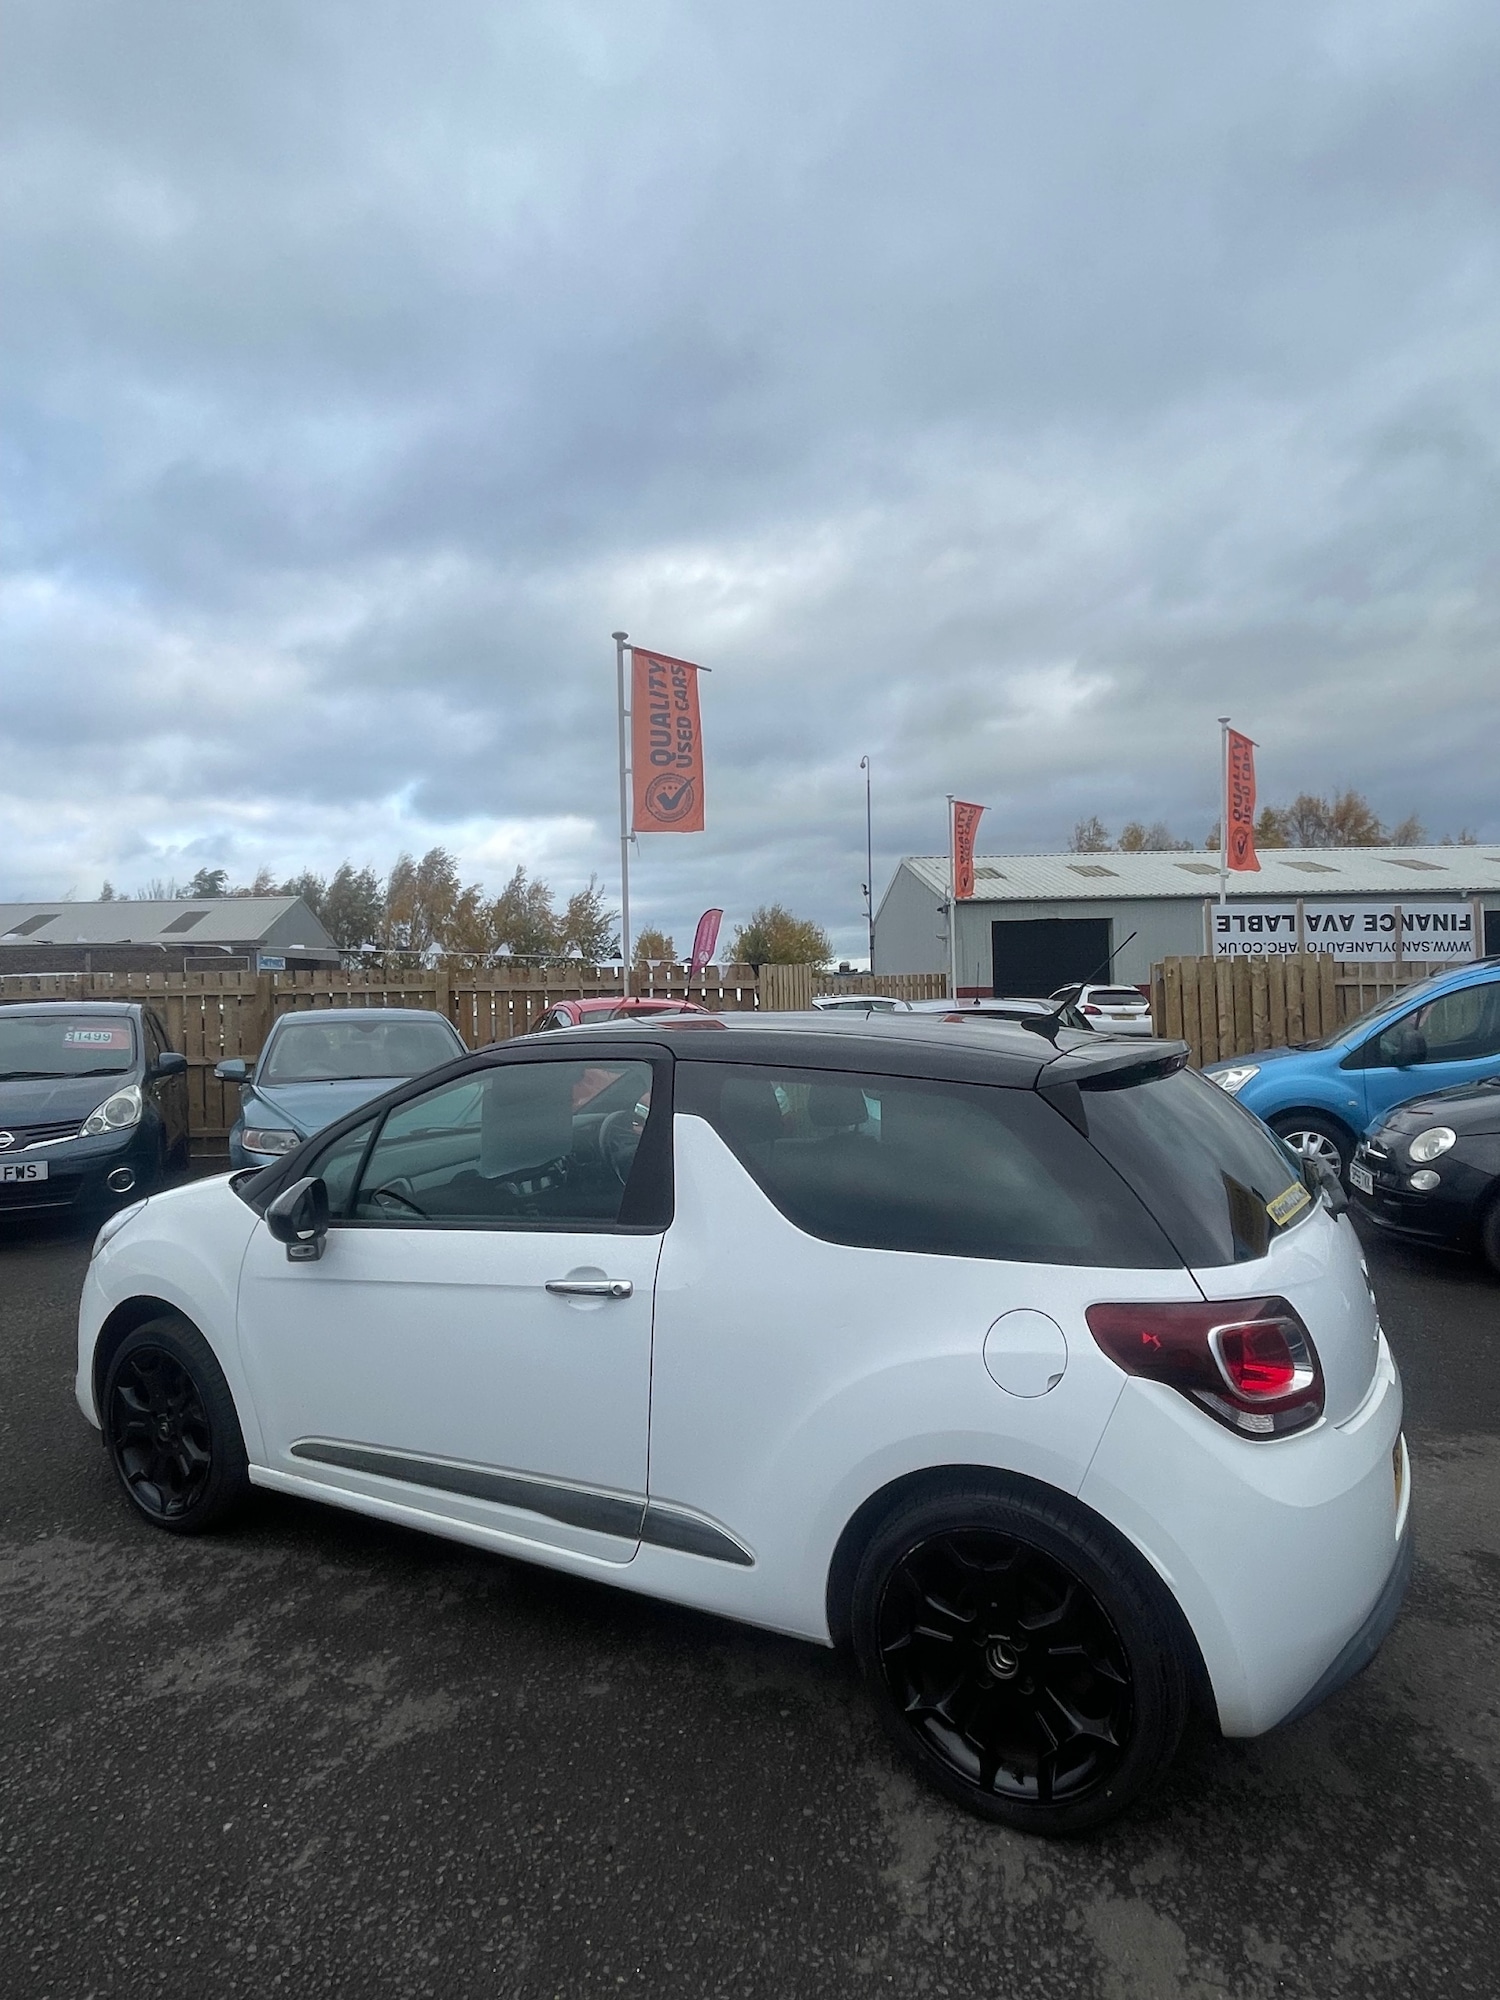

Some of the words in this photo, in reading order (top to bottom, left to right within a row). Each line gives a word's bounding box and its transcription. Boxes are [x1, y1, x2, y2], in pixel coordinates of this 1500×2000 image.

[671, 664, 690, 712] CARS
[648, 660, 677, 767] QUALITY
[676, 714, 693, 769] USED
[1232, 739, 1243, 821] QUALITY
[958, 808, 967, 864] QUALITY
[1216, 914, 1355, 933] AVALABLE
[1364, 913, 1472, 932] FINANCE
[1218, 940, 1472, 954] WWW.SANYLANEAUTOARC.CO.UK
[64, 1031, 111, 1043] £1499
